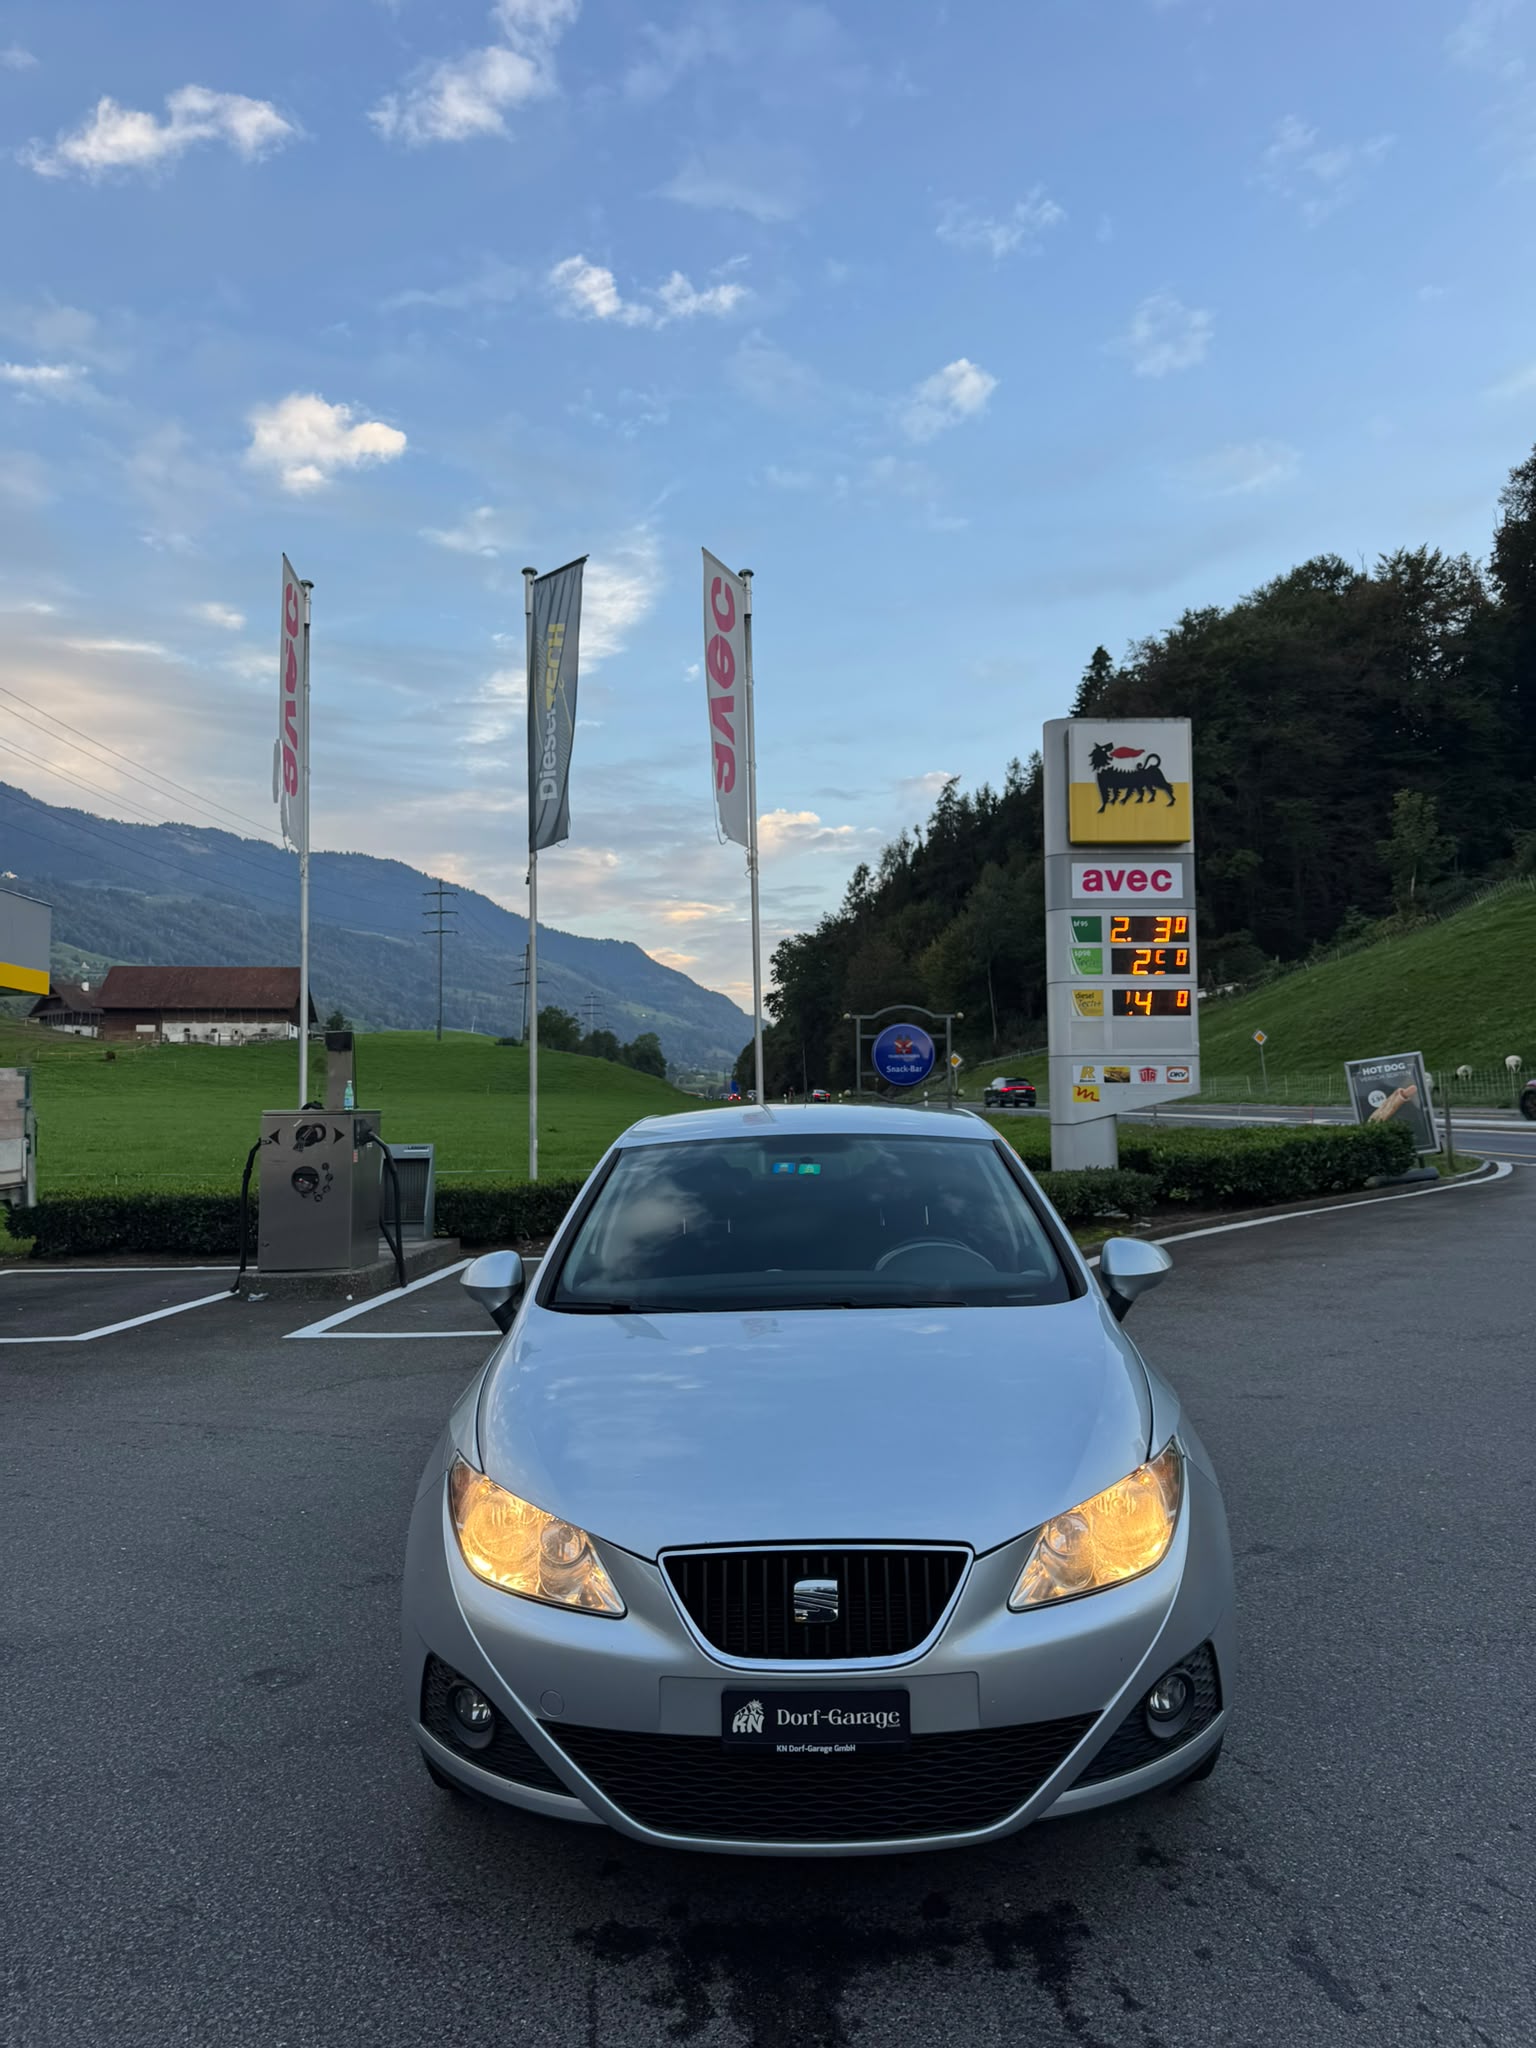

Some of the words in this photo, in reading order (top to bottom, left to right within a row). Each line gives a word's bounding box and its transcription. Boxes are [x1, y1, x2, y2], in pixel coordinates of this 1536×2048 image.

[1082, 869, 1172, 892] avec
[886, 1065, 922, 1073] Snack-Bar
[1362, 1065, 1382, 1076] HOT
[1384, 1063, 1405, 1072] DOG
[732, 1714, 765, 1733] KN
[777, 1708, 900, 1729] Dorf-Garage
[776, 1744, 788, 1752] KN
[788, 1744, 833, 1754] Dorf-Garage
[833, 1744, 856, 1752] GmbH
